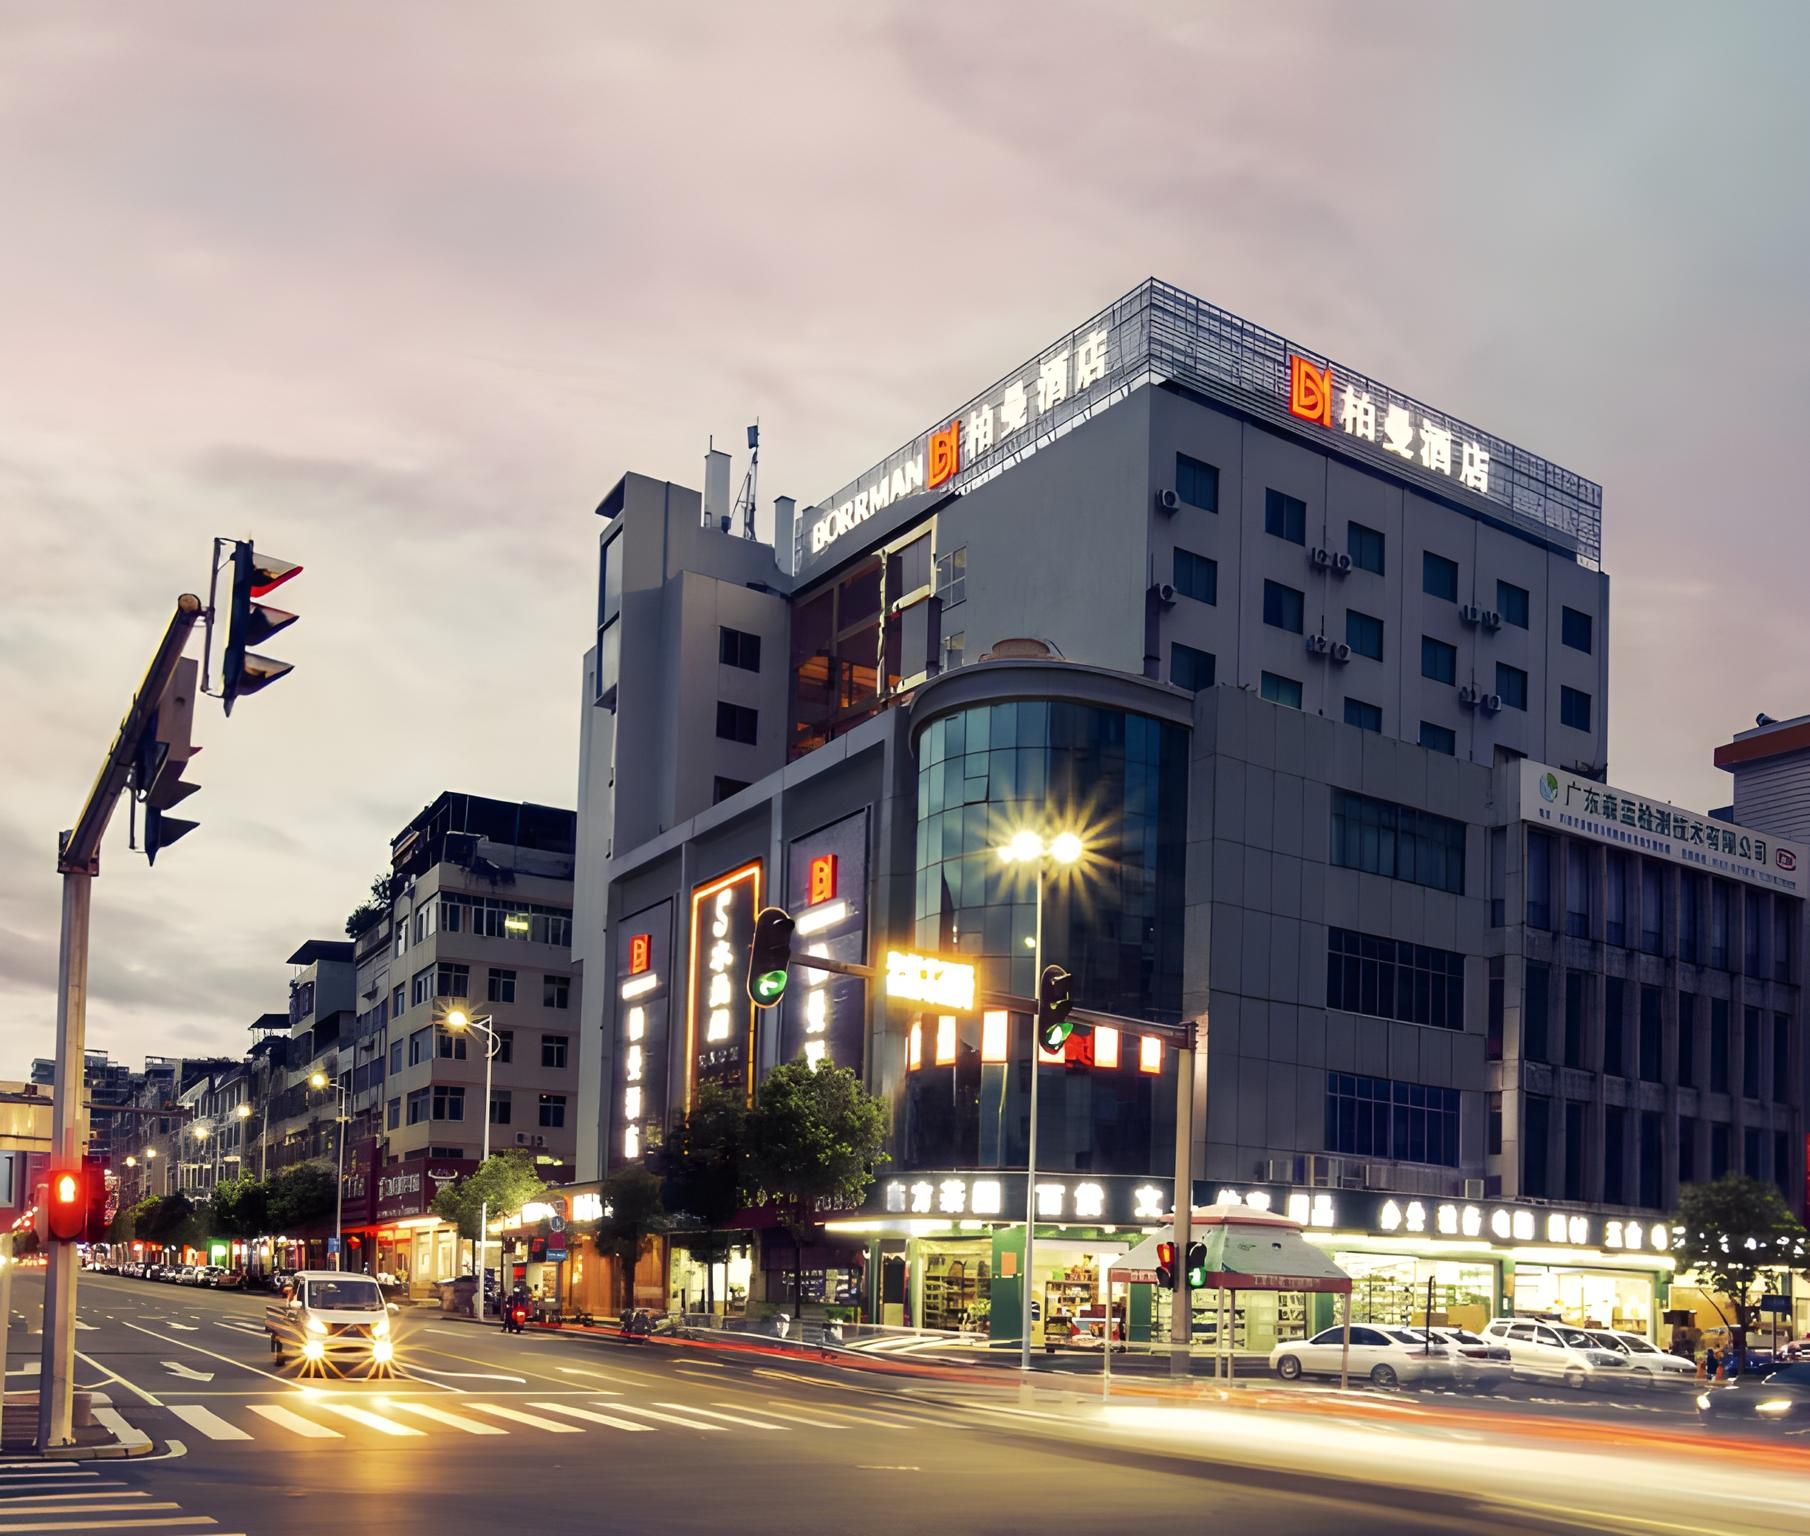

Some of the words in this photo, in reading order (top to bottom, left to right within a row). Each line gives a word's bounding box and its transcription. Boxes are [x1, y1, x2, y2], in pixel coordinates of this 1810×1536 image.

[812, 454, 924, 554] BORRMAN
[964, 329, 1108, 461] 柏曼酒店
[1339, 384, 1490, 493] 柏曼酒店
